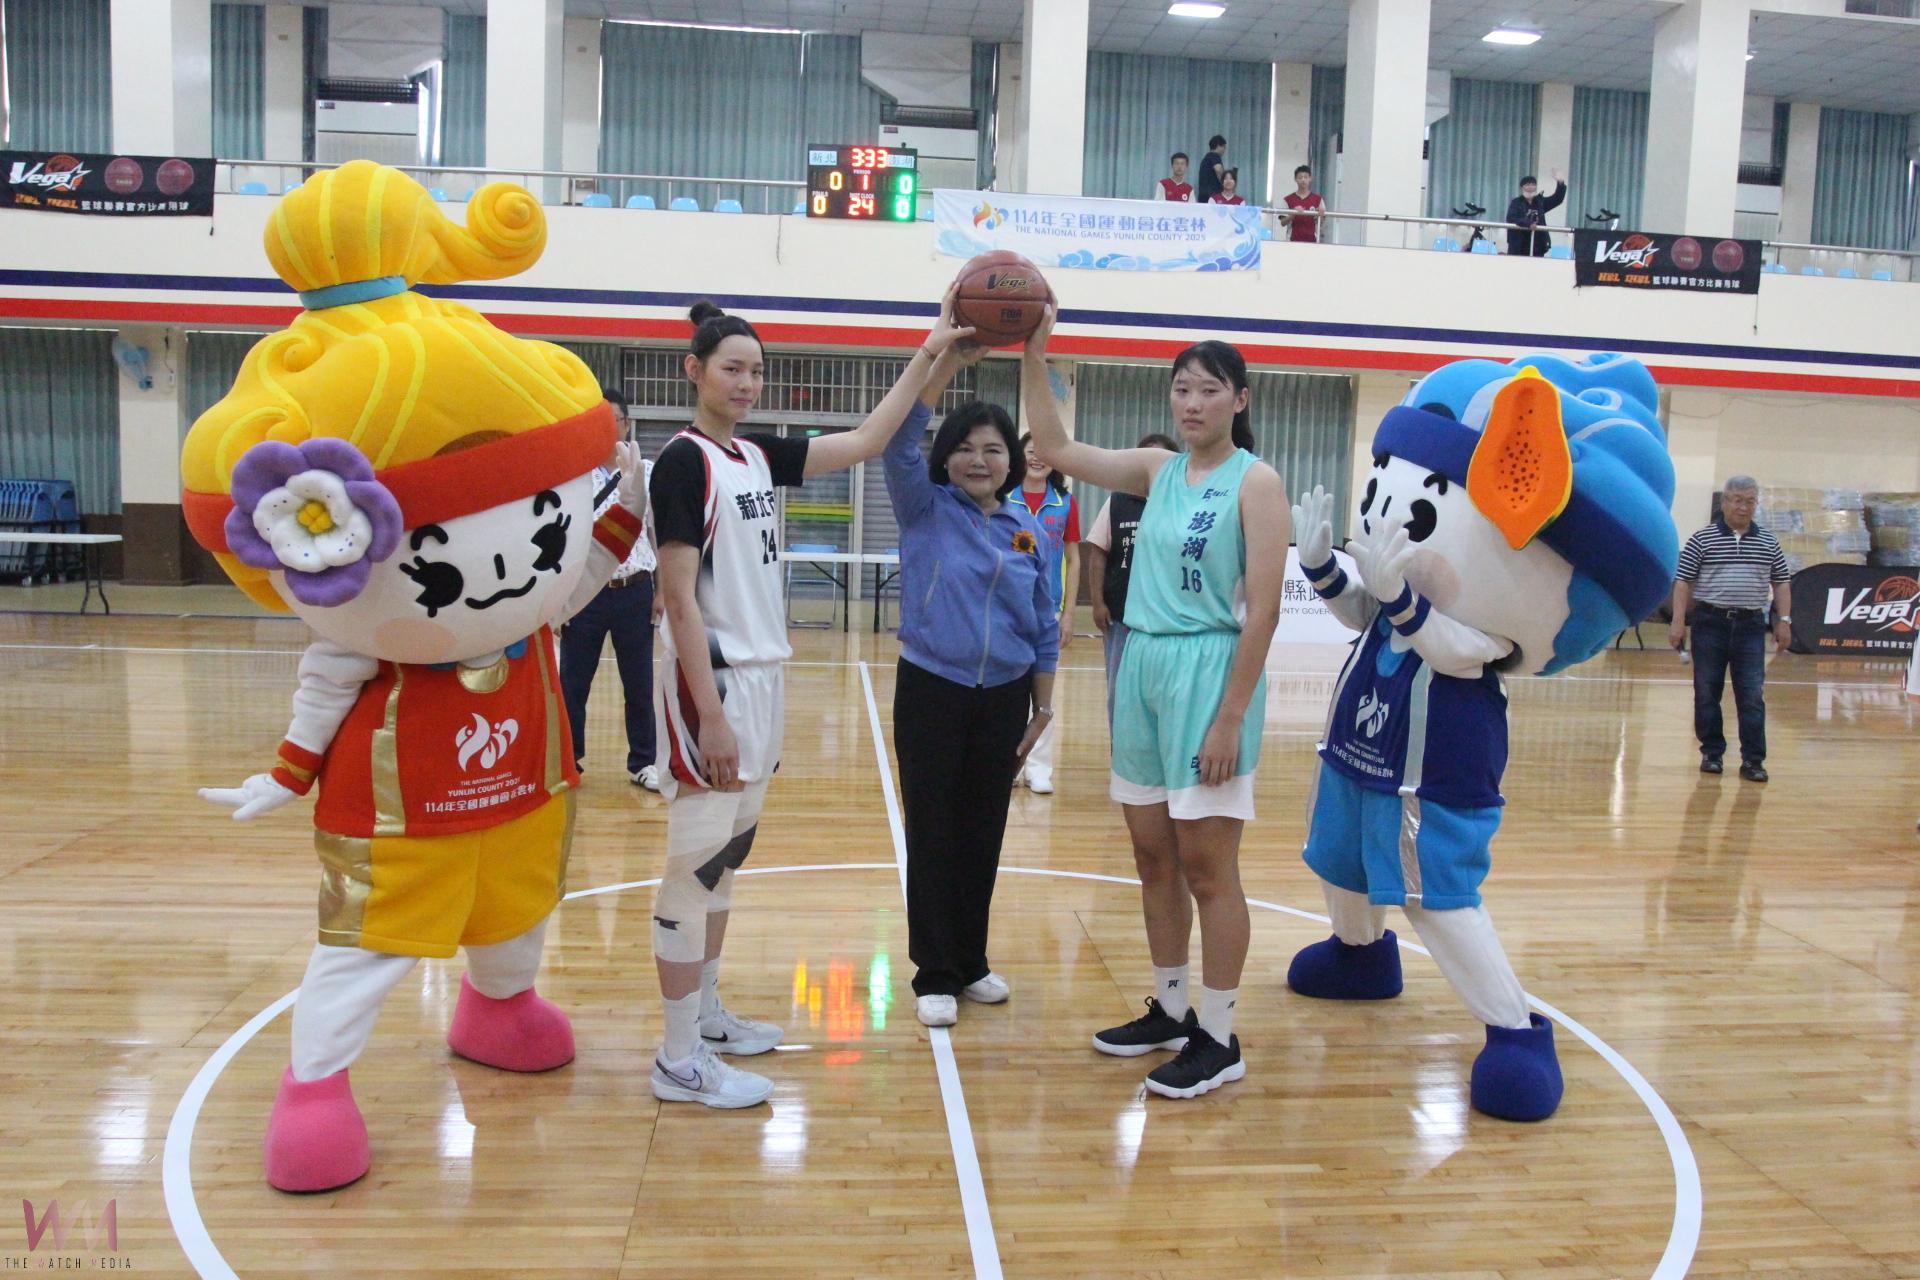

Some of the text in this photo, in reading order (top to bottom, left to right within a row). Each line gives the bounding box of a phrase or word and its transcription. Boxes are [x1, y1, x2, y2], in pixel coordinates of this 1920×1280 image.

[8, 162, 72, 187] Vega
[829, 171, 842, 191] 0
[862, 174, 869, 190] 1
[899, 175, 913, 195] 0
[813, 197, 827, 215] 0
[848, 198, 874, 216] 24
[1014, 208, 1207, 233] 114年全國運動會在雲林
[1016, 225, 1031, 234] THE
[1035, 227, 1077, 238] NATIONAL
[1081, 230, 1110, 240] GAMES
[1114, 232, 1145, 241] YUNLIN
[1148, 233, 1182, 241] COUNTY
[1594, 240, 1639, 263] Vega
[987, 273, 1027, 290] Vega
[761, 528, 777, 564] 24
[1181, 510, 1216, 562] 澎湖
[1181, 566, 1202, 593] 16
[1823, 588, 1911, 624] Vega
[448, 787, 476, 798] YUNLIN
[477, 782, 504, 794] COUNTY
